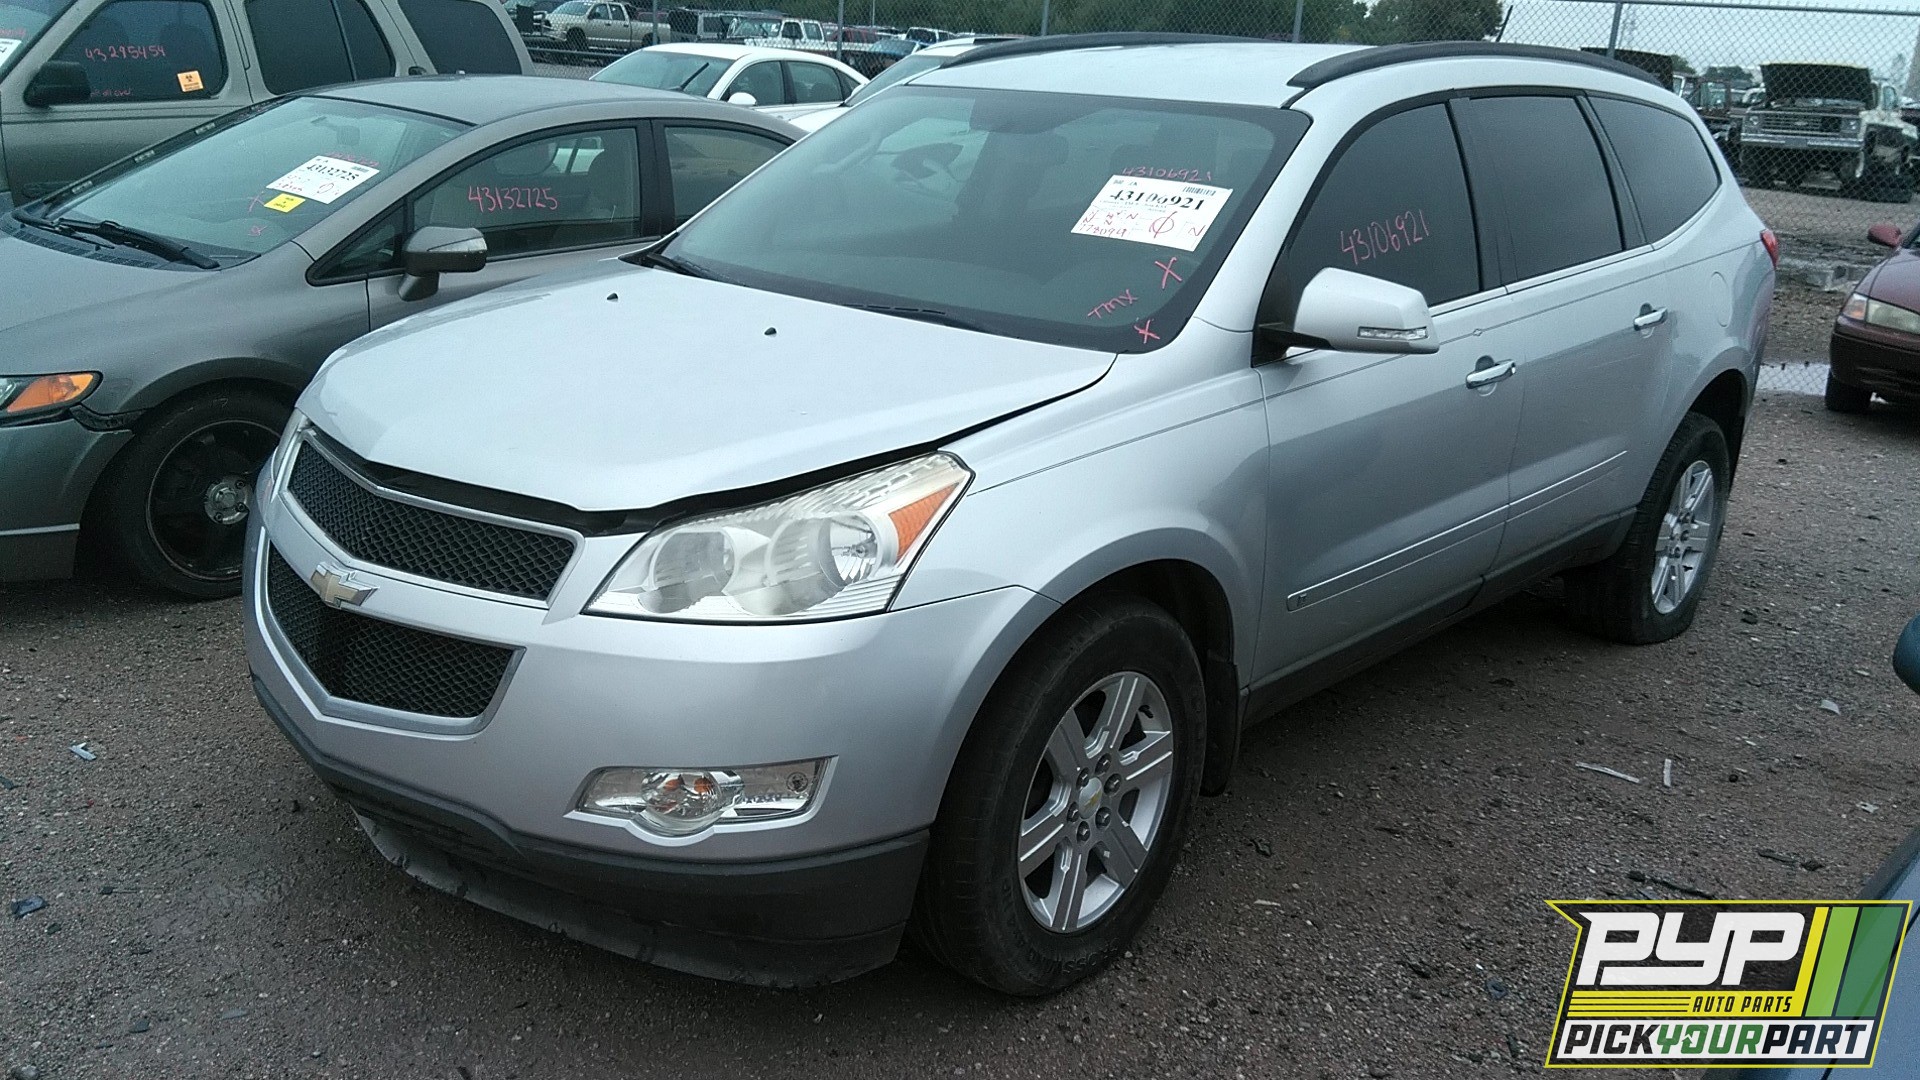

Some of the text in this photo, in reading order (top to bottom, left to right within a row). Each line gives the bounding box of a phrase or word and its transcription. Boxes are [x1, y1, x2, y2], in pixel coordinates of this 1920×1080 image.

[1122, 166, 1212, 182] 43106921
[468, 186, 558, 213] 43132725
[1109, 189, 1205, 210] 43106921
[1340, 208, 1430, 265] 43106921
